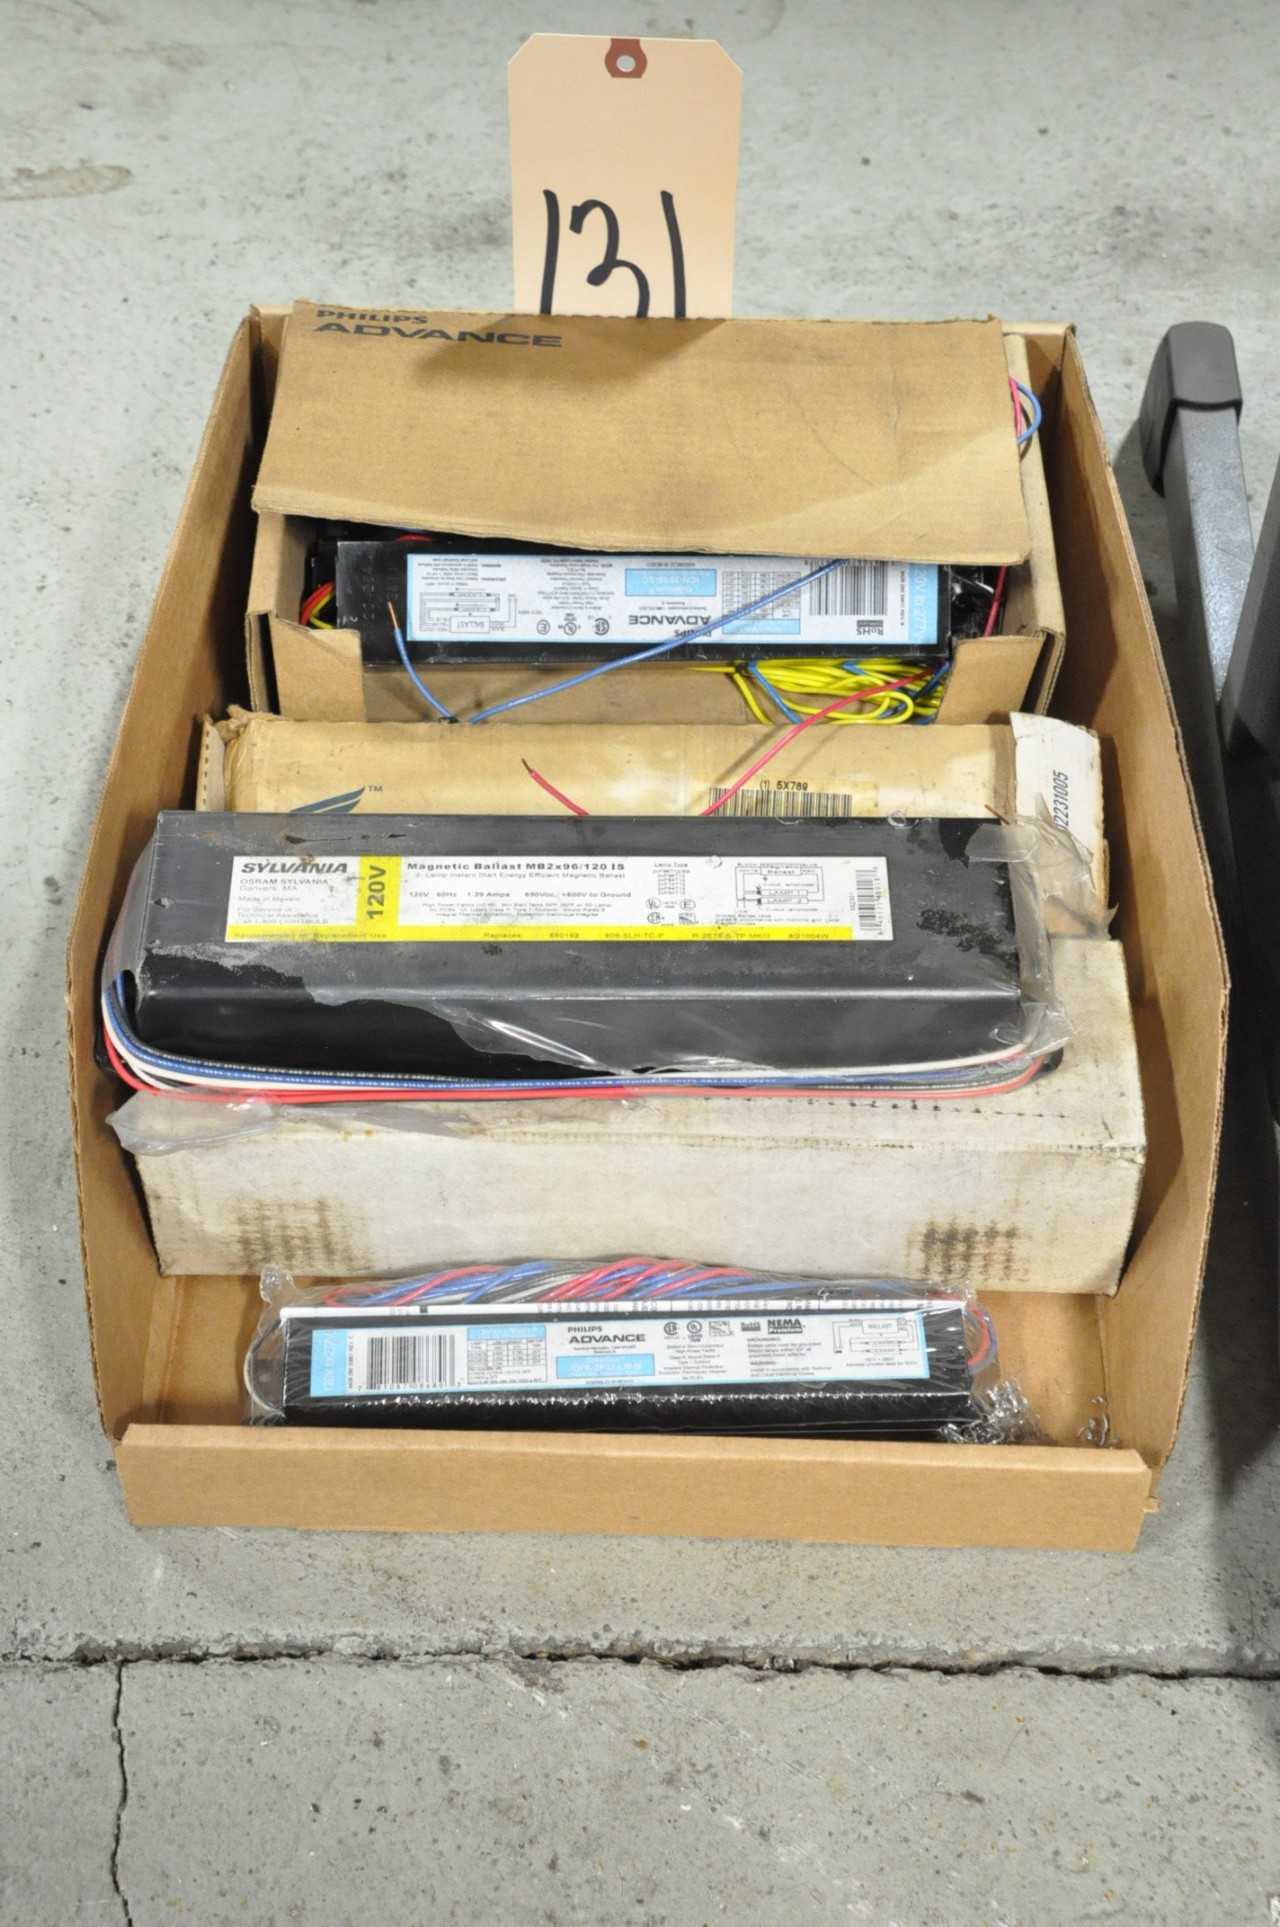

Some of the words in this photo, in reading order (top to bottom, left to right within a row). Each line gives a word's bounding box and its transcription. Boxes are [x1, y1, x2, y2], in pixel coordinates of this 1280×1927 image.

[540, 189, 686, 320] 131
[316, 309, 428, 325] PHILIPS
[313, 322, 563, 349] ADVANCE
[628, 615, 711, 625] ADVANCE
[368, 785, 383, 793] TM
[241, 862, 348, 874] SYLVANIA
[407, 862, 470, 871] Magnetic
[474, 862, 521, 871] Ballast
[240, 878, 278, 886] OSRAM
[280, 878, 329, 886] SYLVANIA
[366, 865, 387, 920] 120V
[768, 1319, 801, 1327] NEMA
[569, 1334, 646, 1344] ADVANCE
